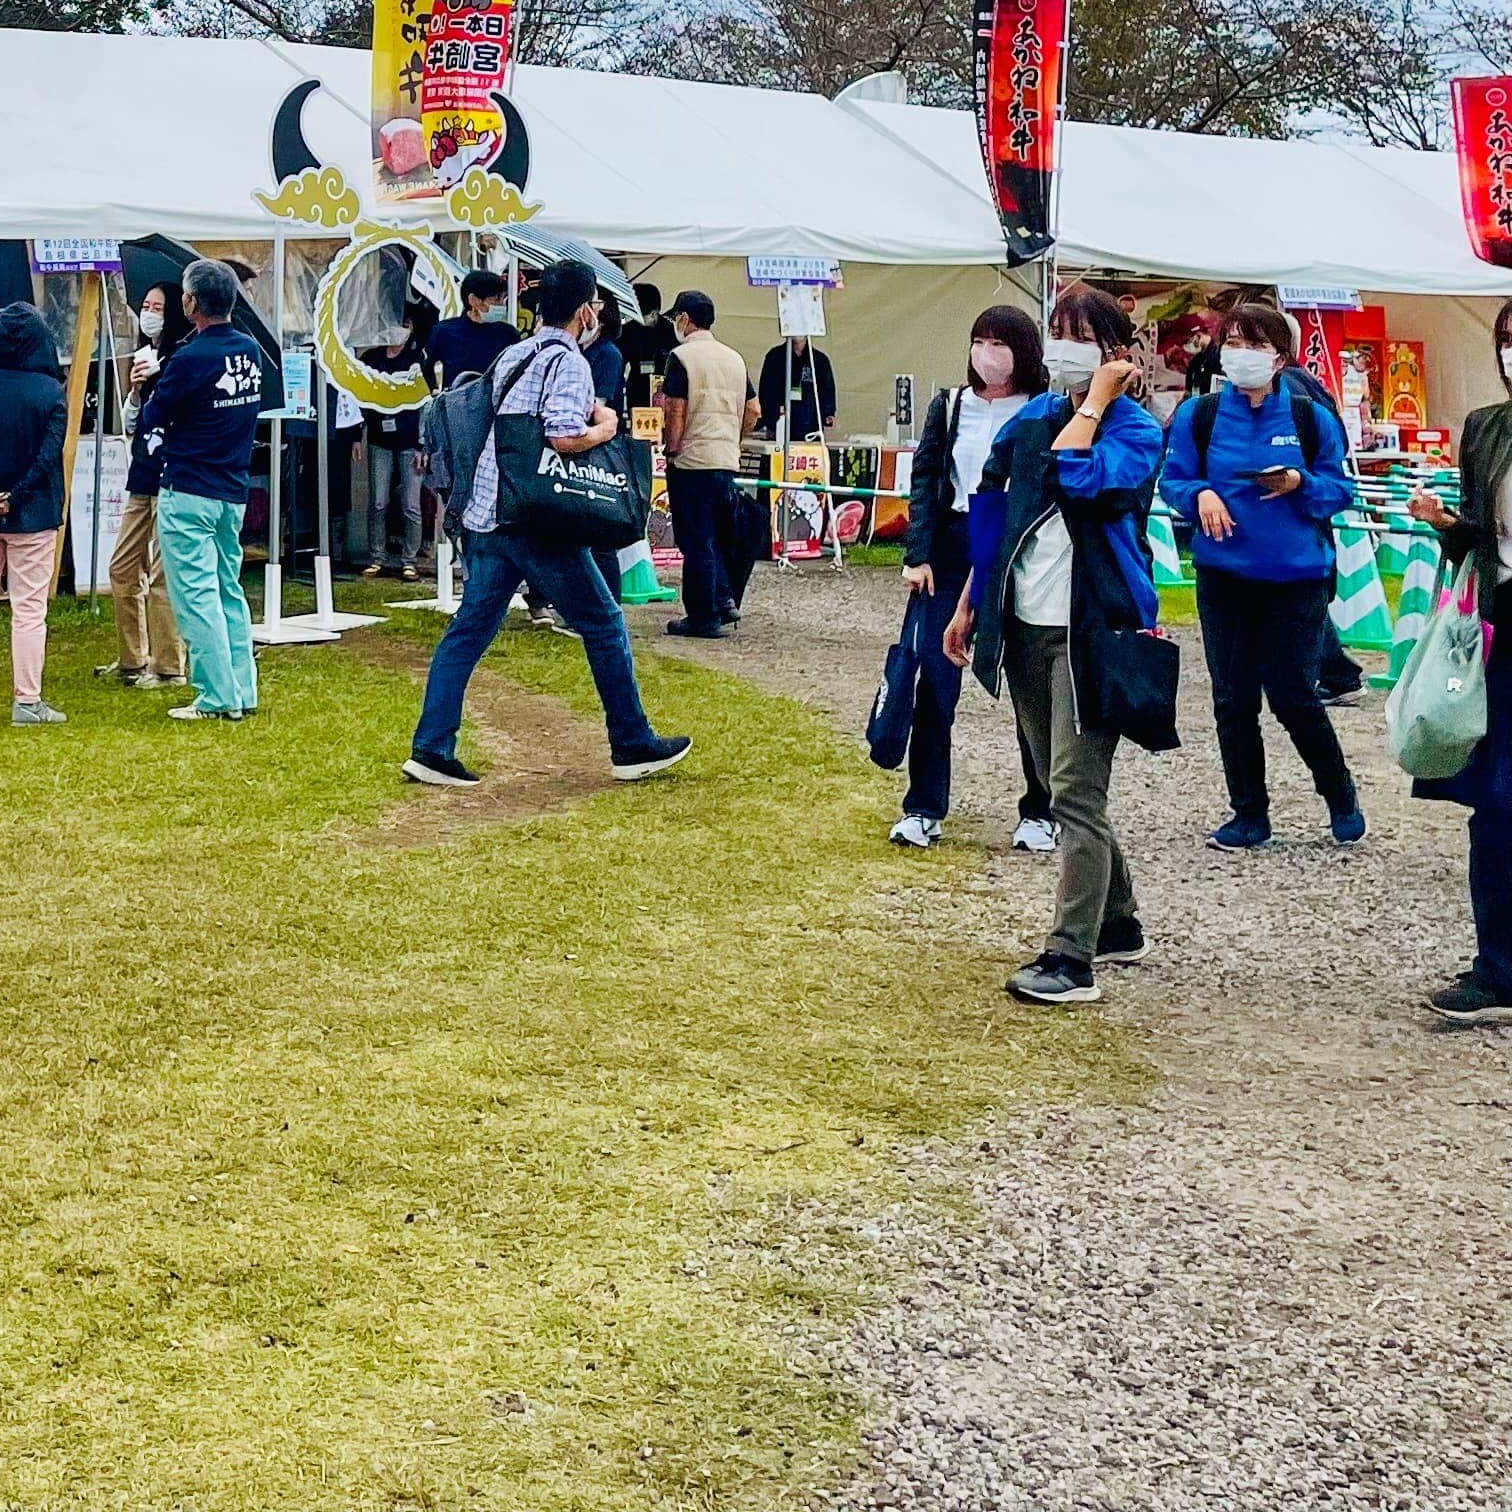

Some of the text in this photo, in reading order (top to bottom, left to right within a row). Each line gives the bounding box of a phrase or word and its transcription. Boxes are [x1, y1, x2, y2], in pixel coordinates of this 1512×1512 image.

[1007, 16, 1042, 161] あかね和牛
